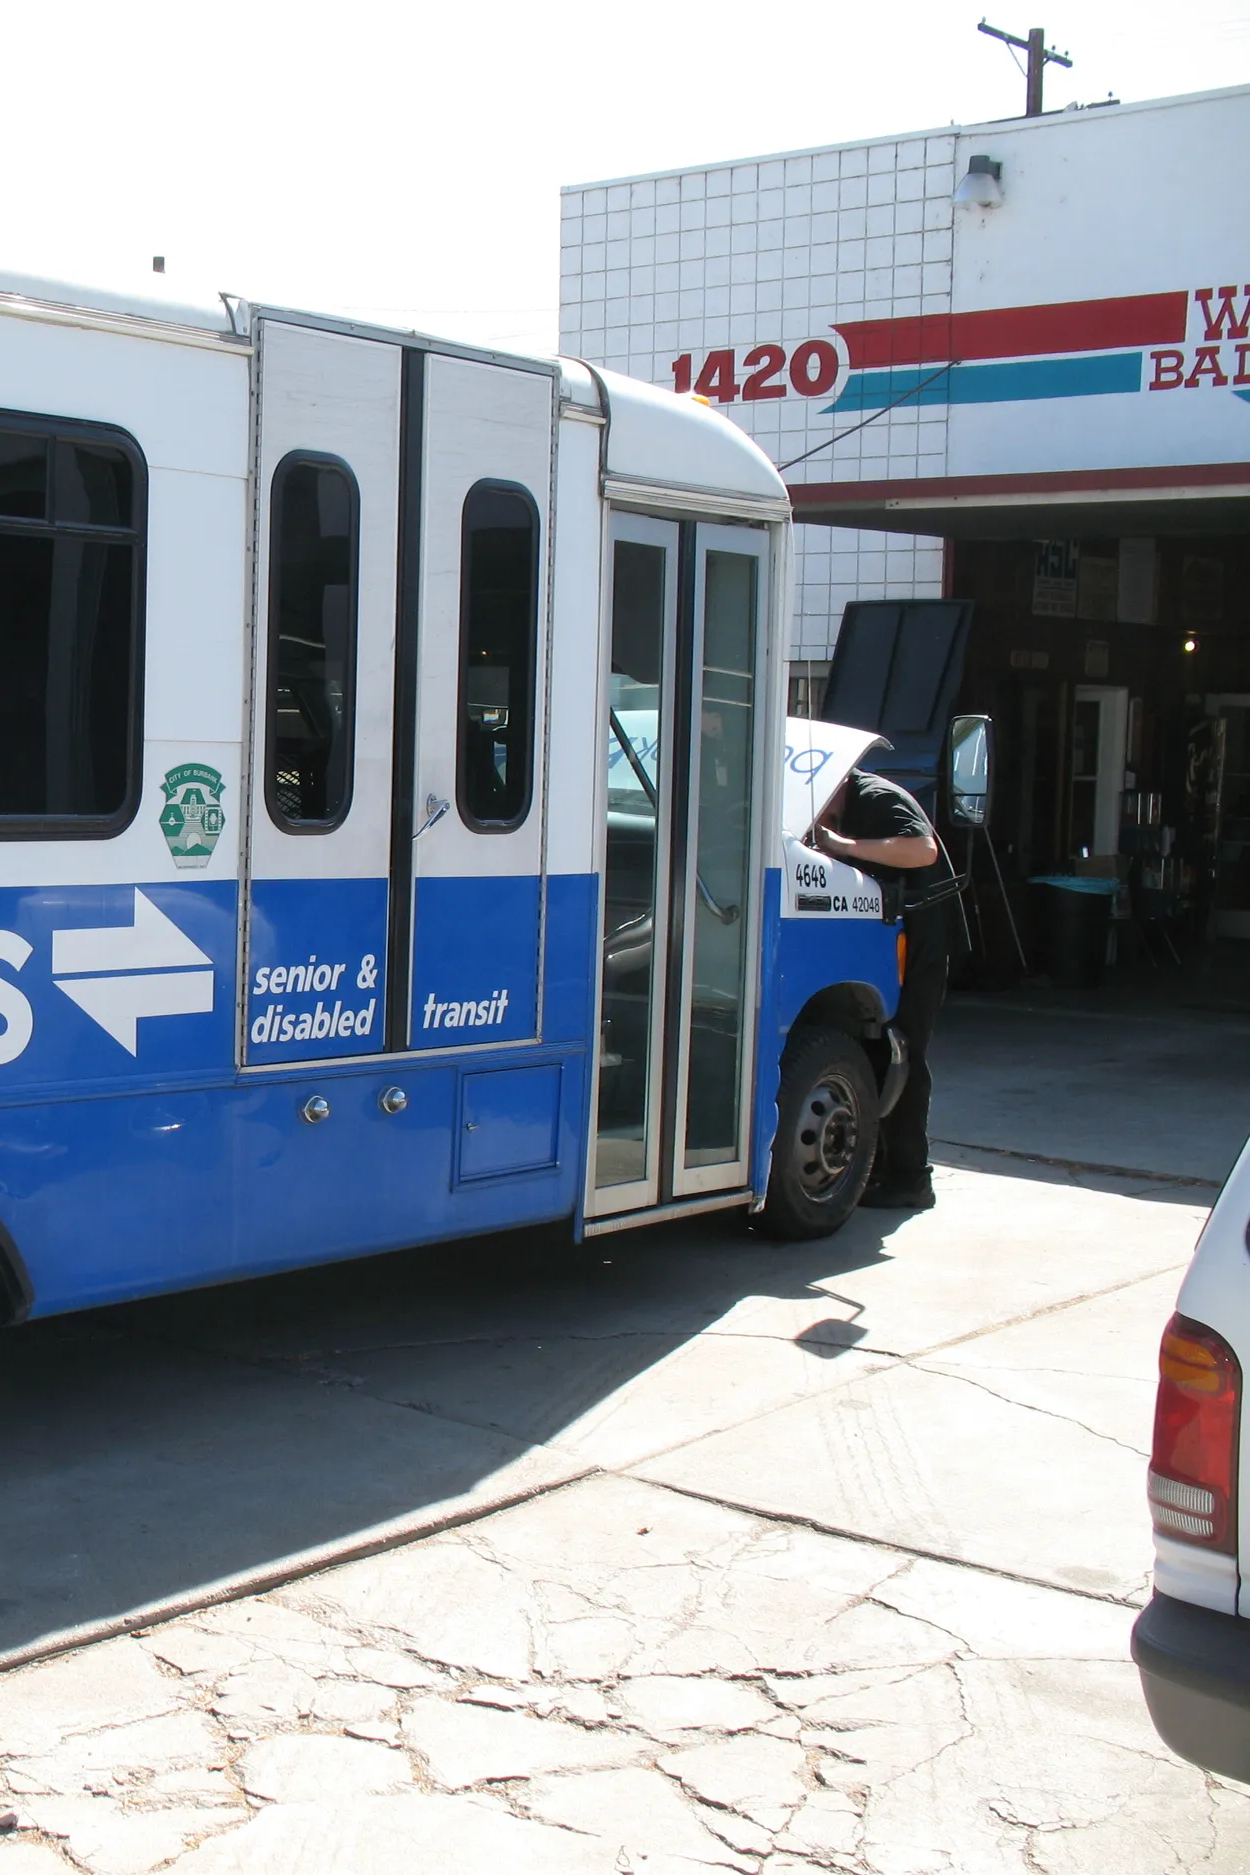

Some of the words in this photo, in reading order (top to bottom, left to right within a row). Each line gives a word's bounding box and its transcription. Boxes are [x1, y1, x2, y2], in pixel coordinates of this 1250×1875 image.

[671, 339, 838, 403] 1420
[168, 771, 182, 784] CITY
[193, 769, 217, 783] BURBANK
[796, 864, 827, 889] 4648
[833, 895, 849, 912] CA
[852, 897, 880, 913] 42048
[252, 955, 346, 995] senior
[356, 954, 378, 990] &
[251, 998, 376, 1044] disabled
[422, 989, 508, 1029] transit
